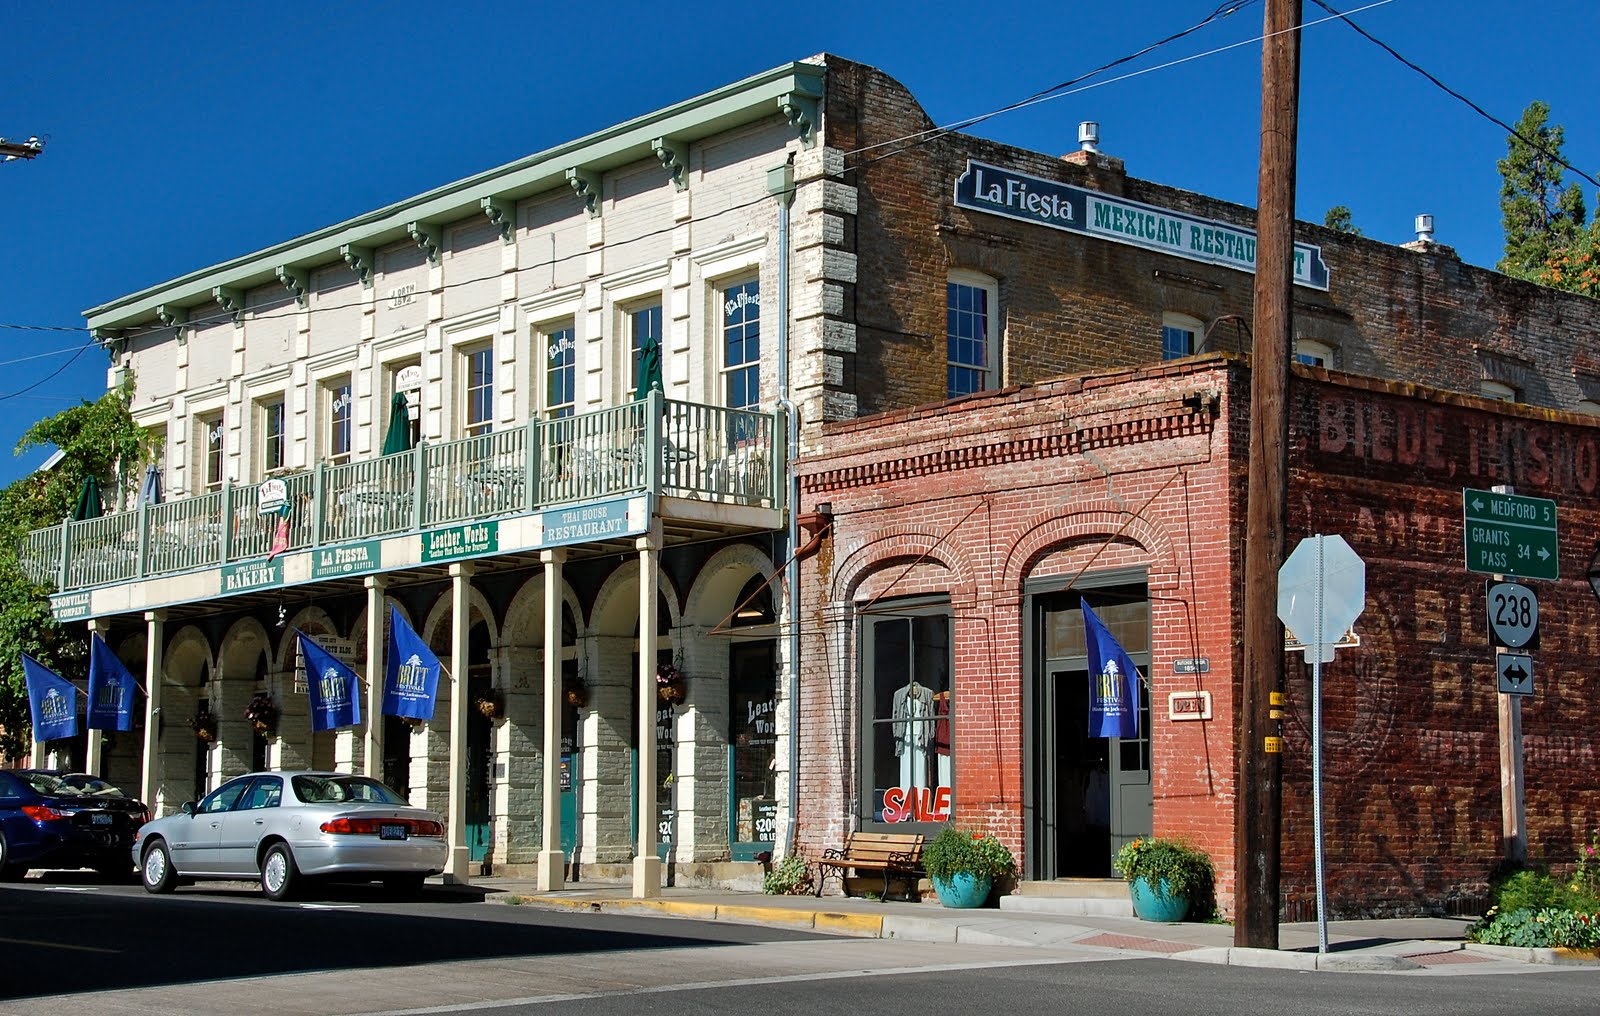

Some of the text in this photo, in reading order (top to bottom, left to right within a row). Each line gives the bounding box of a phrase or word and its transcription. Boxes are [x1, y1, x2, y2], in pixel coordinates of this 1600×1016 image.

[1094, 201, 1305, 275] MEXICAN RESTAUT
[561, 506, 608, 524] THAI HOUSE
[1491, 500, 1550, 521] MEDFORD 5
[430, 523, 489, 550] Leather Works
[547, 518, 623, 541] RESTAURANT
[1472, 527, 1510, 546] GRANTS
[321, 546, 369, 567] LA FIESTA
[1481, 550, 1507, 568] PASS
[1517, 544, 1531, 560] 34
[227, 567, 276, 590] BAKERY
[1495, 593, 1532, 628] 238
[1096, 673, 1124, 698] BRITT
[748, 699, 778, 724] Leat
[1174, 699, 1206, 712] OPEN
[755, 720, 775, 734] Wor
[882, 786, 952, 824] SALE
[759, 832, 769, 841] OR
